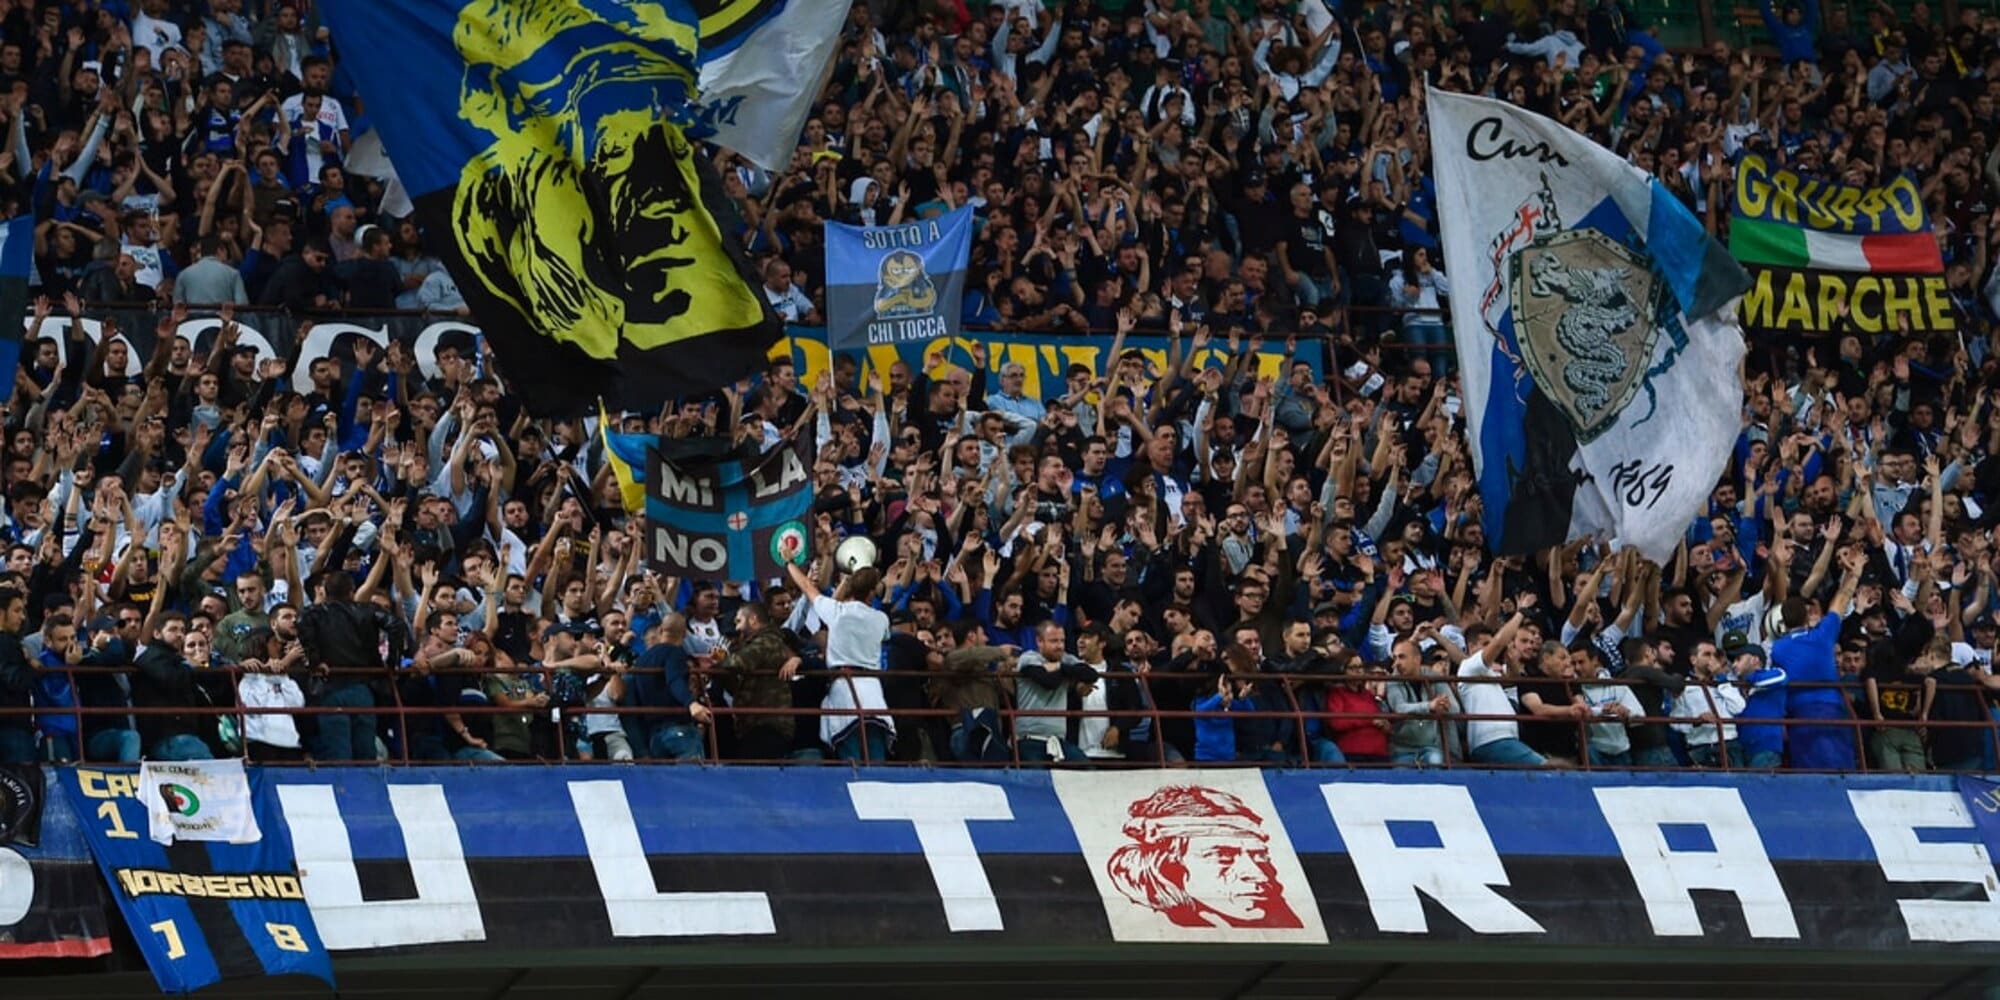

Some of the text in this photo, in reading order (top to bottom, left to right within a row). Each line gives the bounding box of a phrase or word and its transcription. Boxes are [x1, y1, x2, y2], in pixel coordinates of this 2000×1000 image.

[1737, 155, 1924, 231] GRUPPO
[863, 220, 940, 249] SOTTO A
[1742, 269, 1955, 333] MARCHE
[868, 315, 947, 343] CHI TOCCA
[655, 527, 727, 571] NO
[77, 769, 139, 798] CA
[98, 801, 138, 839] 1
